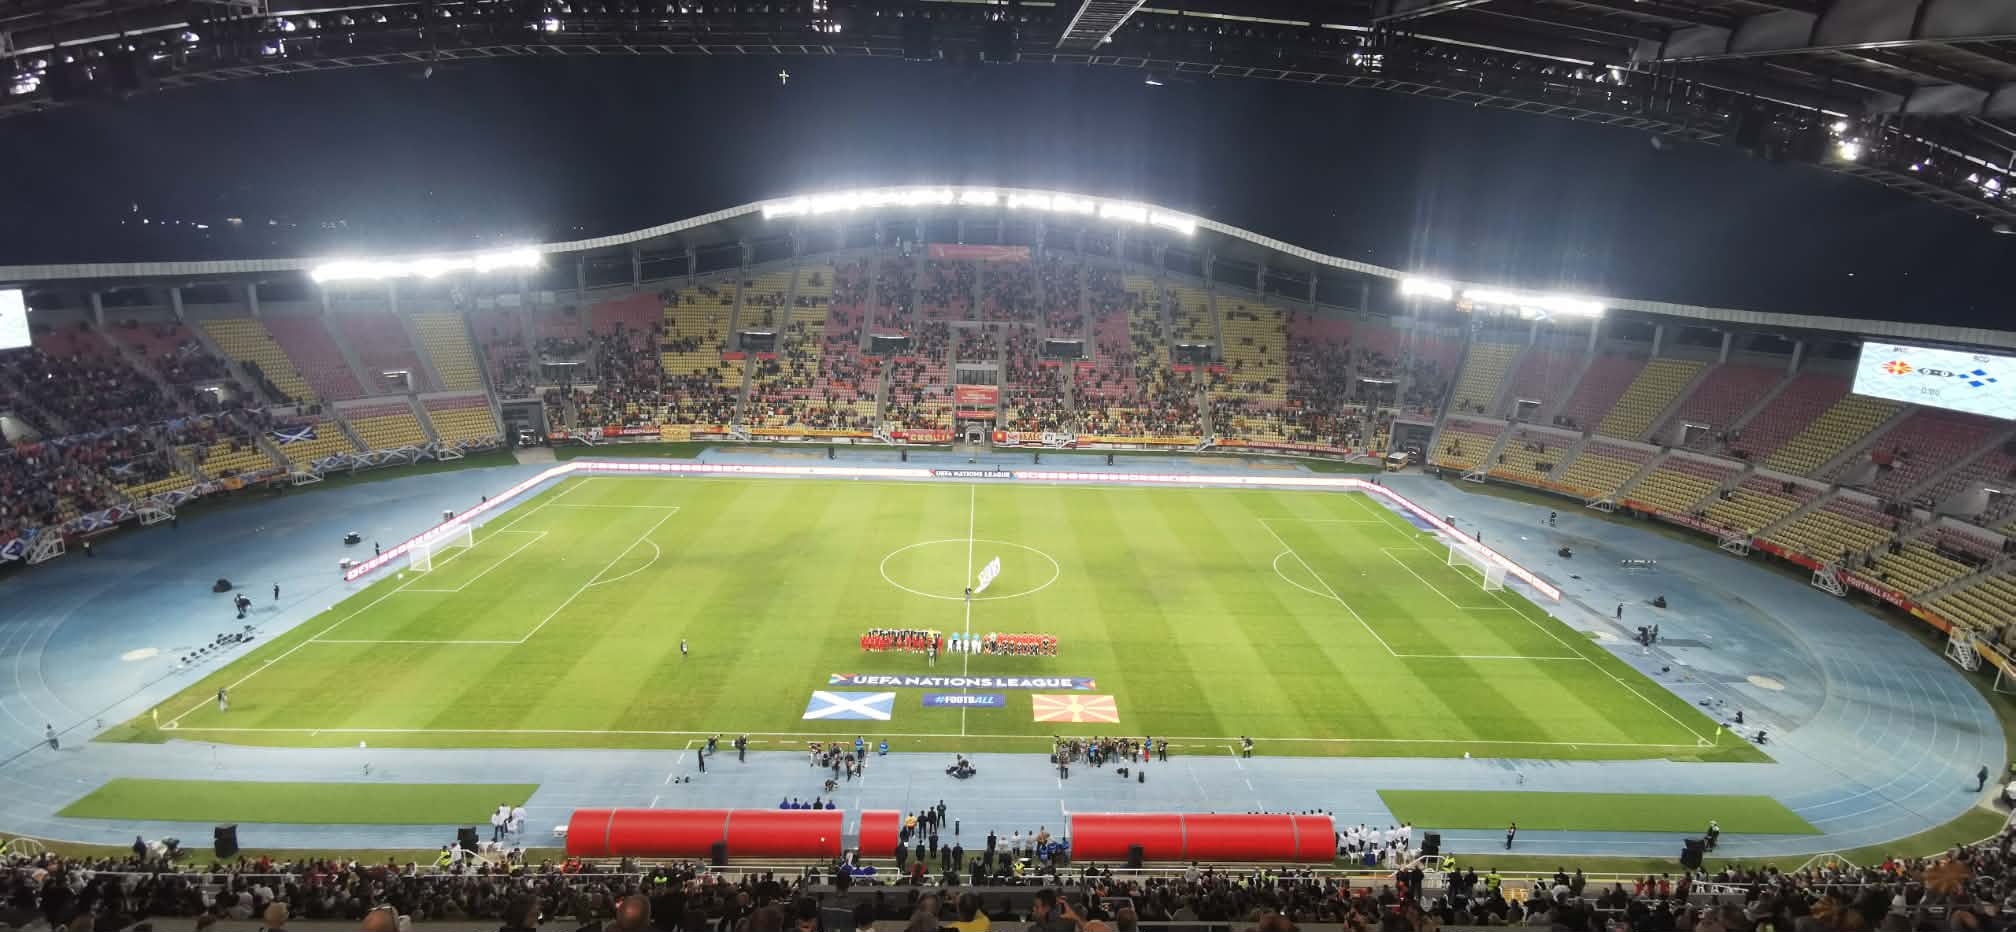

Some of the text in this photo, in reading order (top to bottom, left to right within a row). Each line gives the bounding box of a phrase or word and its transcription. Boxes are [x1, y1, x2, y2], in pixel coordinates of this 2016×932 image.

[1847, 576, 1881, 596] FOOTBALL
[853, 676, 1073, 688] UEFA NATIONS LEAGUE
[935, 695, 995, 704] #FOOTBALL
